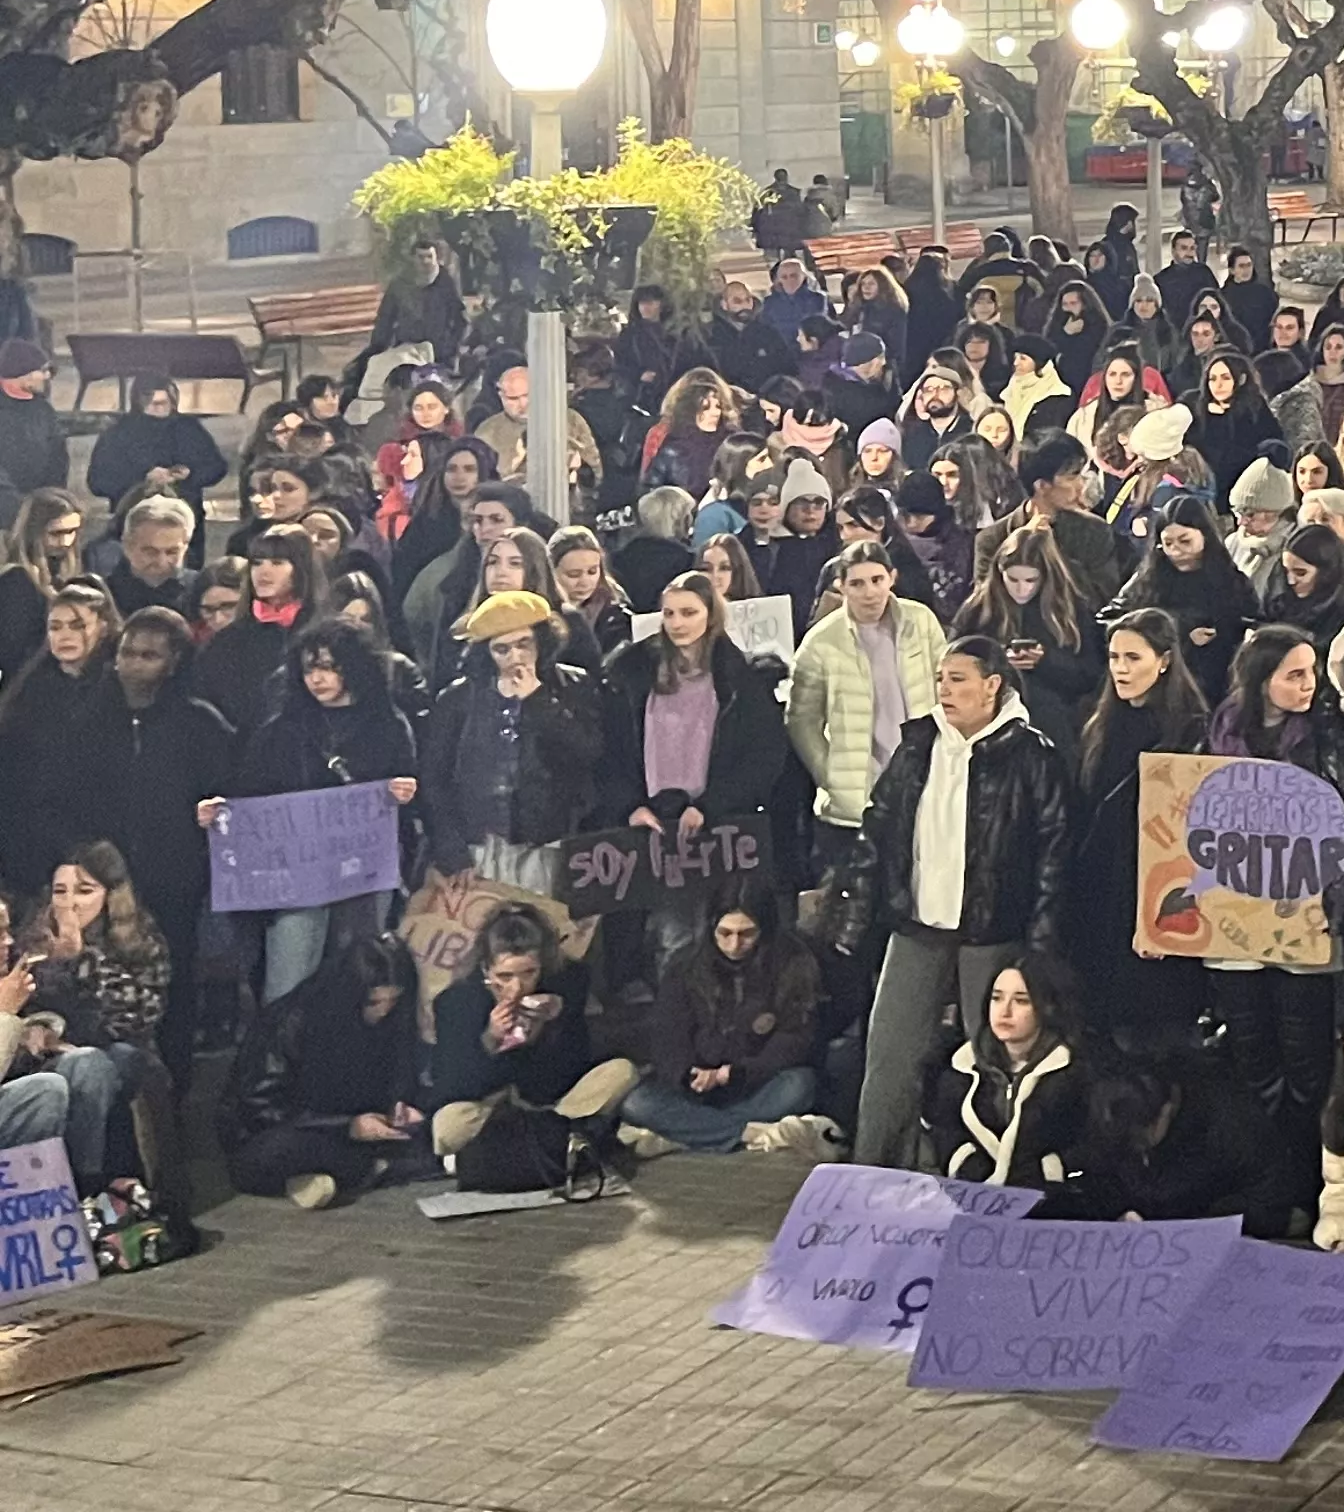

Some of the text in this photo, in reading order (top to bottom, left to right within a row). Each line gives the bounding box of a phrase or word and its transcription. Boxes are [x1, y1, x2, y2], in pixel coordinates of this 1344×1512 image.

[956, 1225, 1192, 1271] QUEREMOS
[1028, 1272, 1169, 1321] VIVIR
[918, 1334, 984, 1377] NO
[993, 1333, 1160, 1379] SOBREVI
